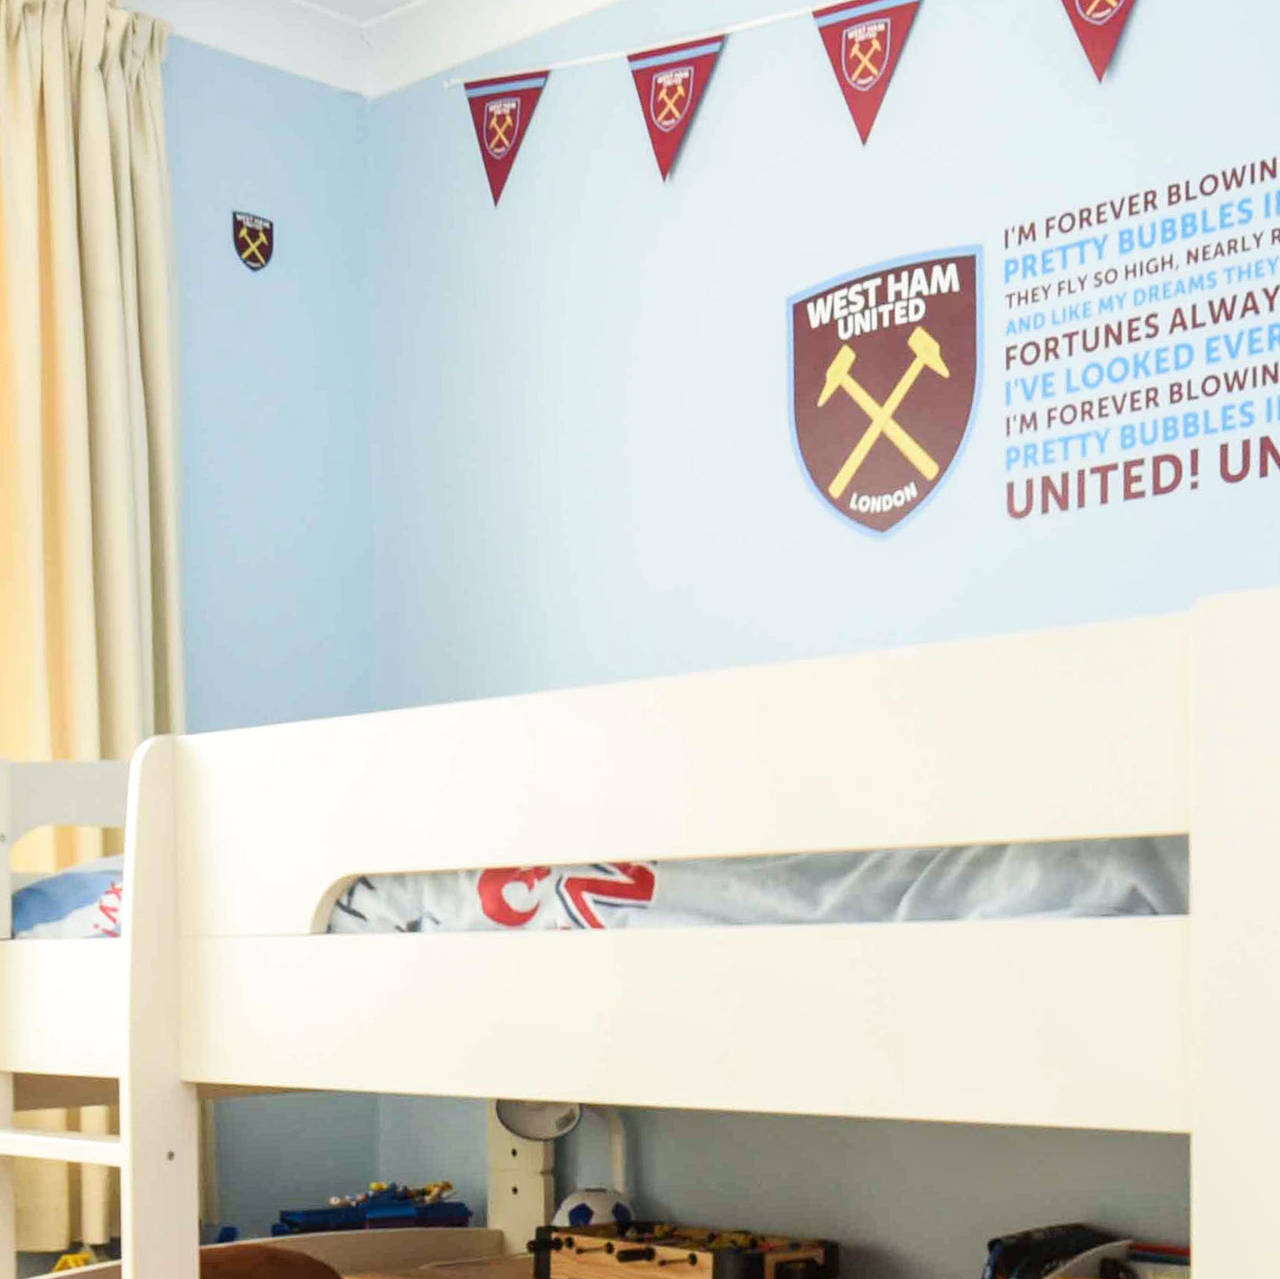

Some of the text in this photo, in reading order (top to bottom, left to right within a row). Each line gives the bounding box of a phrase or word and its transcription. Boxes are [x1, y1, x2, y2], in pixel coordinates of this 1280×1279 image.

[1004, 222, 1036, 250] I'M
[1045, 190, 1158, 239] FOREVER
[1004, 234, 1108, 285] PRETTY
[1118, 197, 1254, 256] BUBBLES
[806, 262, 960, 328] WEST HAM
[1005, 283, 1051, 309] THEY
[1058, 274, 1088, 297] FLY
[1094, 268, 1118, 288] SO
[1124, 253, 1179, 281] HIGH,
[1186, 230, 1264, 266] NEARLY
[1006, 312, 1046, 336] AND
[1052, 301, 1092, 326] LIKE
[1098, 292, 1127, 315] MY
[1133, 270, 1217, 307] DREAMS
[1224, 256, 1279, 284] THEY
[837, 297, 926, 340] UNITED
[1005, 312, 1160, 372] FORTUNES
[1005, 372, 1056, 406] I'VE
[1066, 342, 1195, 394] LOOKED
[1006, 411, 1038, 437] I'M
[1047, 386, 1160, 430] FOREVER
[1006, 427, 1112, 472] PRETTY
[1120, 400, 1256, 451] BUBBLES
[849, 482, 918, 513] LONDON
[1006, 448, 1200, 520] UNITED!
